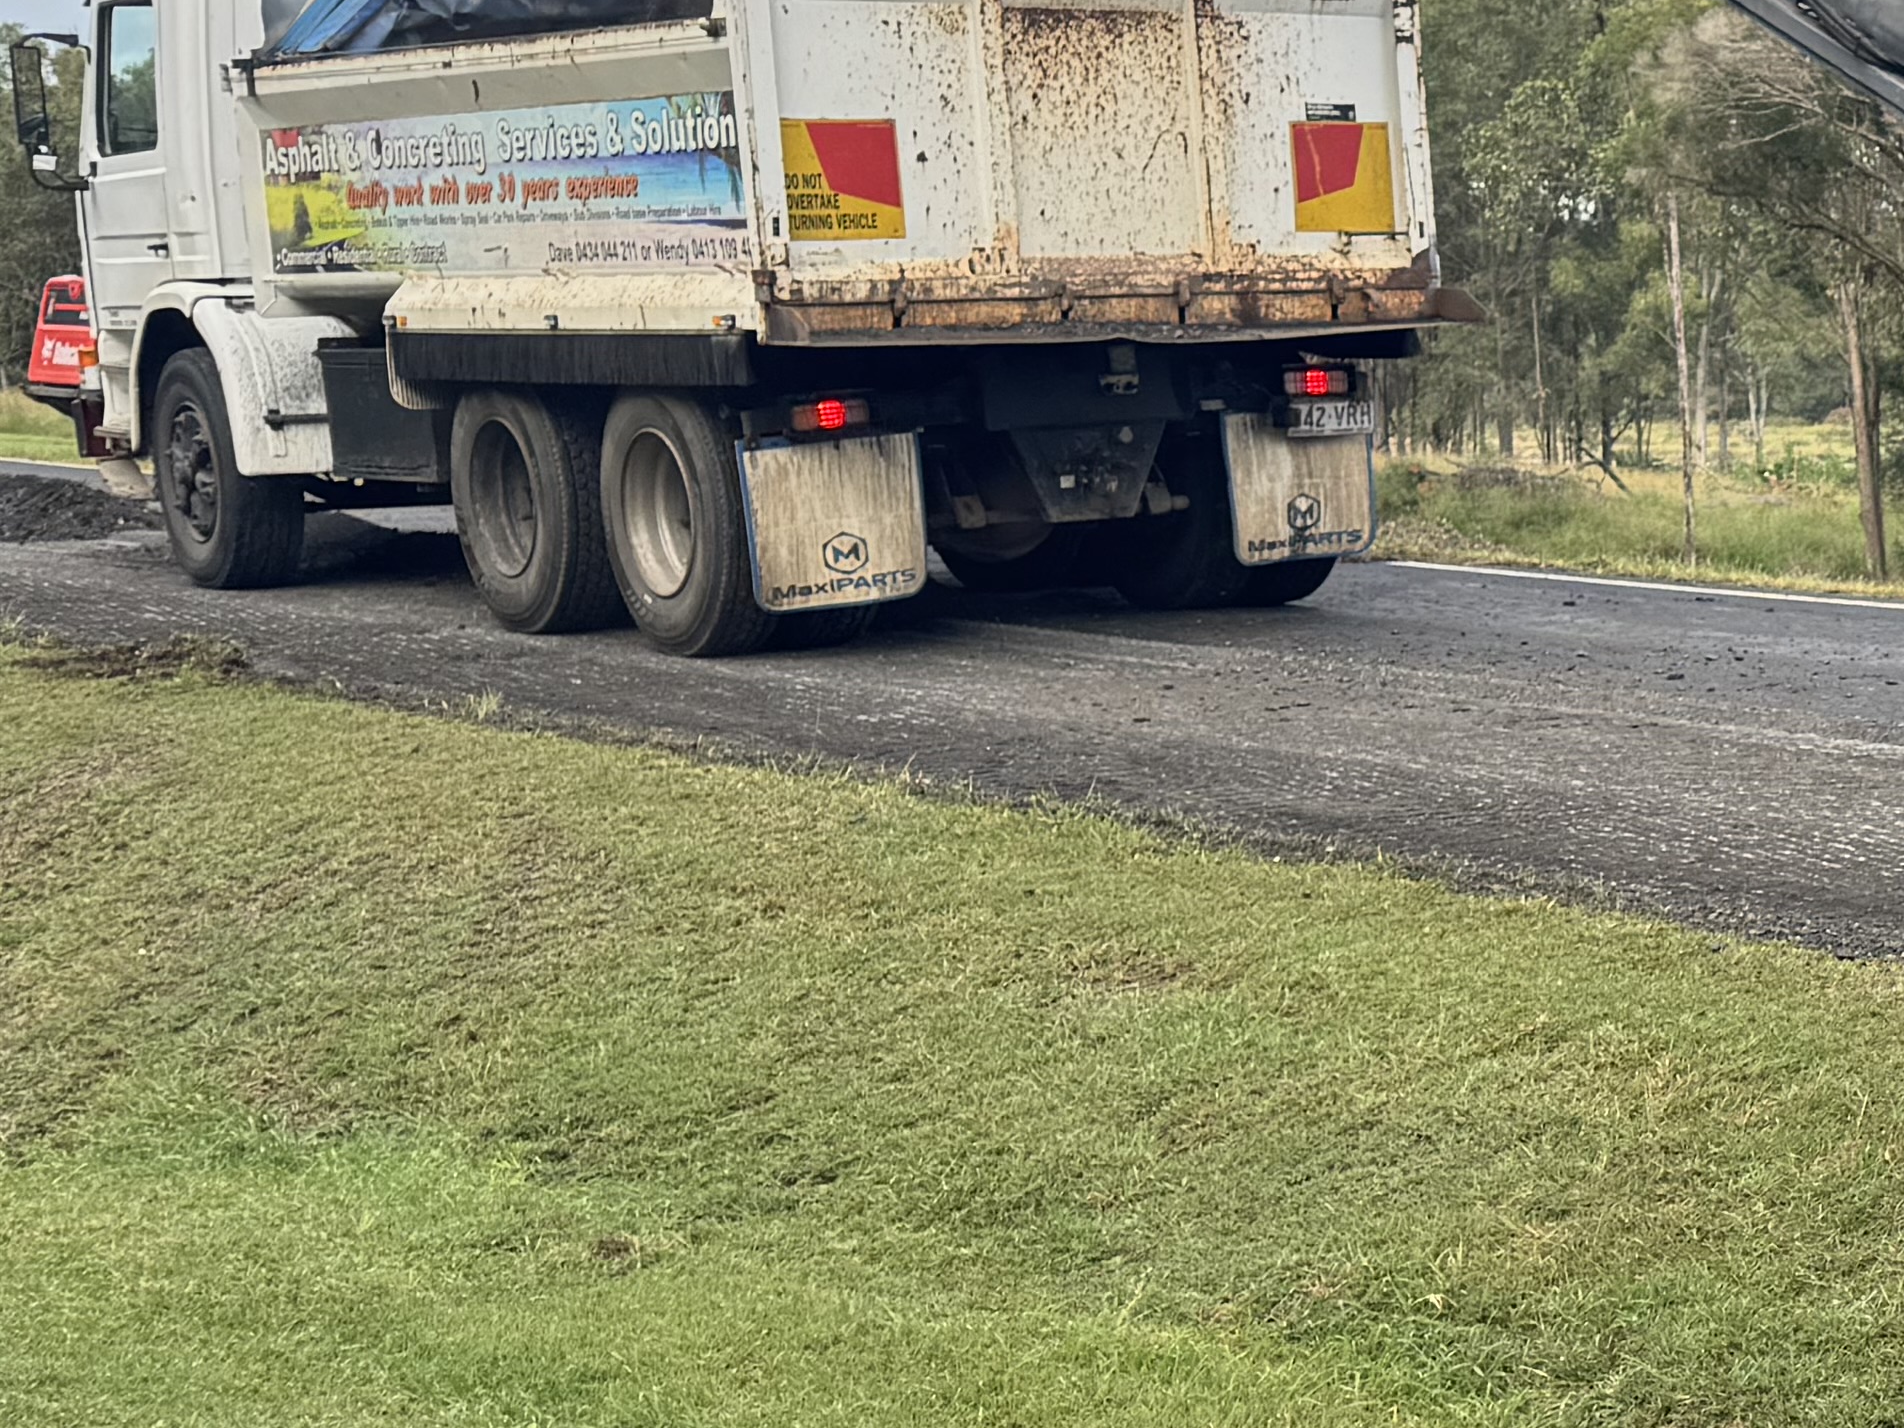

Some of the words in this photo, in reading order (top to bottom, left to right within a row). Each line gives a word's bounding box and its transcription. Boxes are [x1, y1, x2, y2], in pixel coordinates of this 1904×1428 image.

[265, 132, 339, 183] Asphalt
[345, 131, 361, 172] &
[366, 123, 486, 175] Concreting
[496, 115, 599, 163] Services
[605, 109, 625, 156] &
[784, 173, 799, 190] DO
[802, 173, 822, 190] NOT
[346, 180, 388, 216] Quality
[393, 177, 424, 206] work
[429, 174, 459, 204] with
[465, 180, 493, 205] over
[497, 172, 516, 204] 30
[520, 177, 560, 210] years
[566, 174, 639, 207] experience
[786, 193, 840, 210] OVERTAKE
[789, 213, 833, 231] TURNING
[835, 213, 878, 230] VEHICLE
[549, 242, 574, 263] Dave
[575, 241, 600, 262] 0434
[620, 240, 637, 261] 211
[640, 245, 652, 261] or
[653, 239, 690, 265] Wendy
[692, 238, 717, 260] 0413
[720, 237, 738, 260] 109
